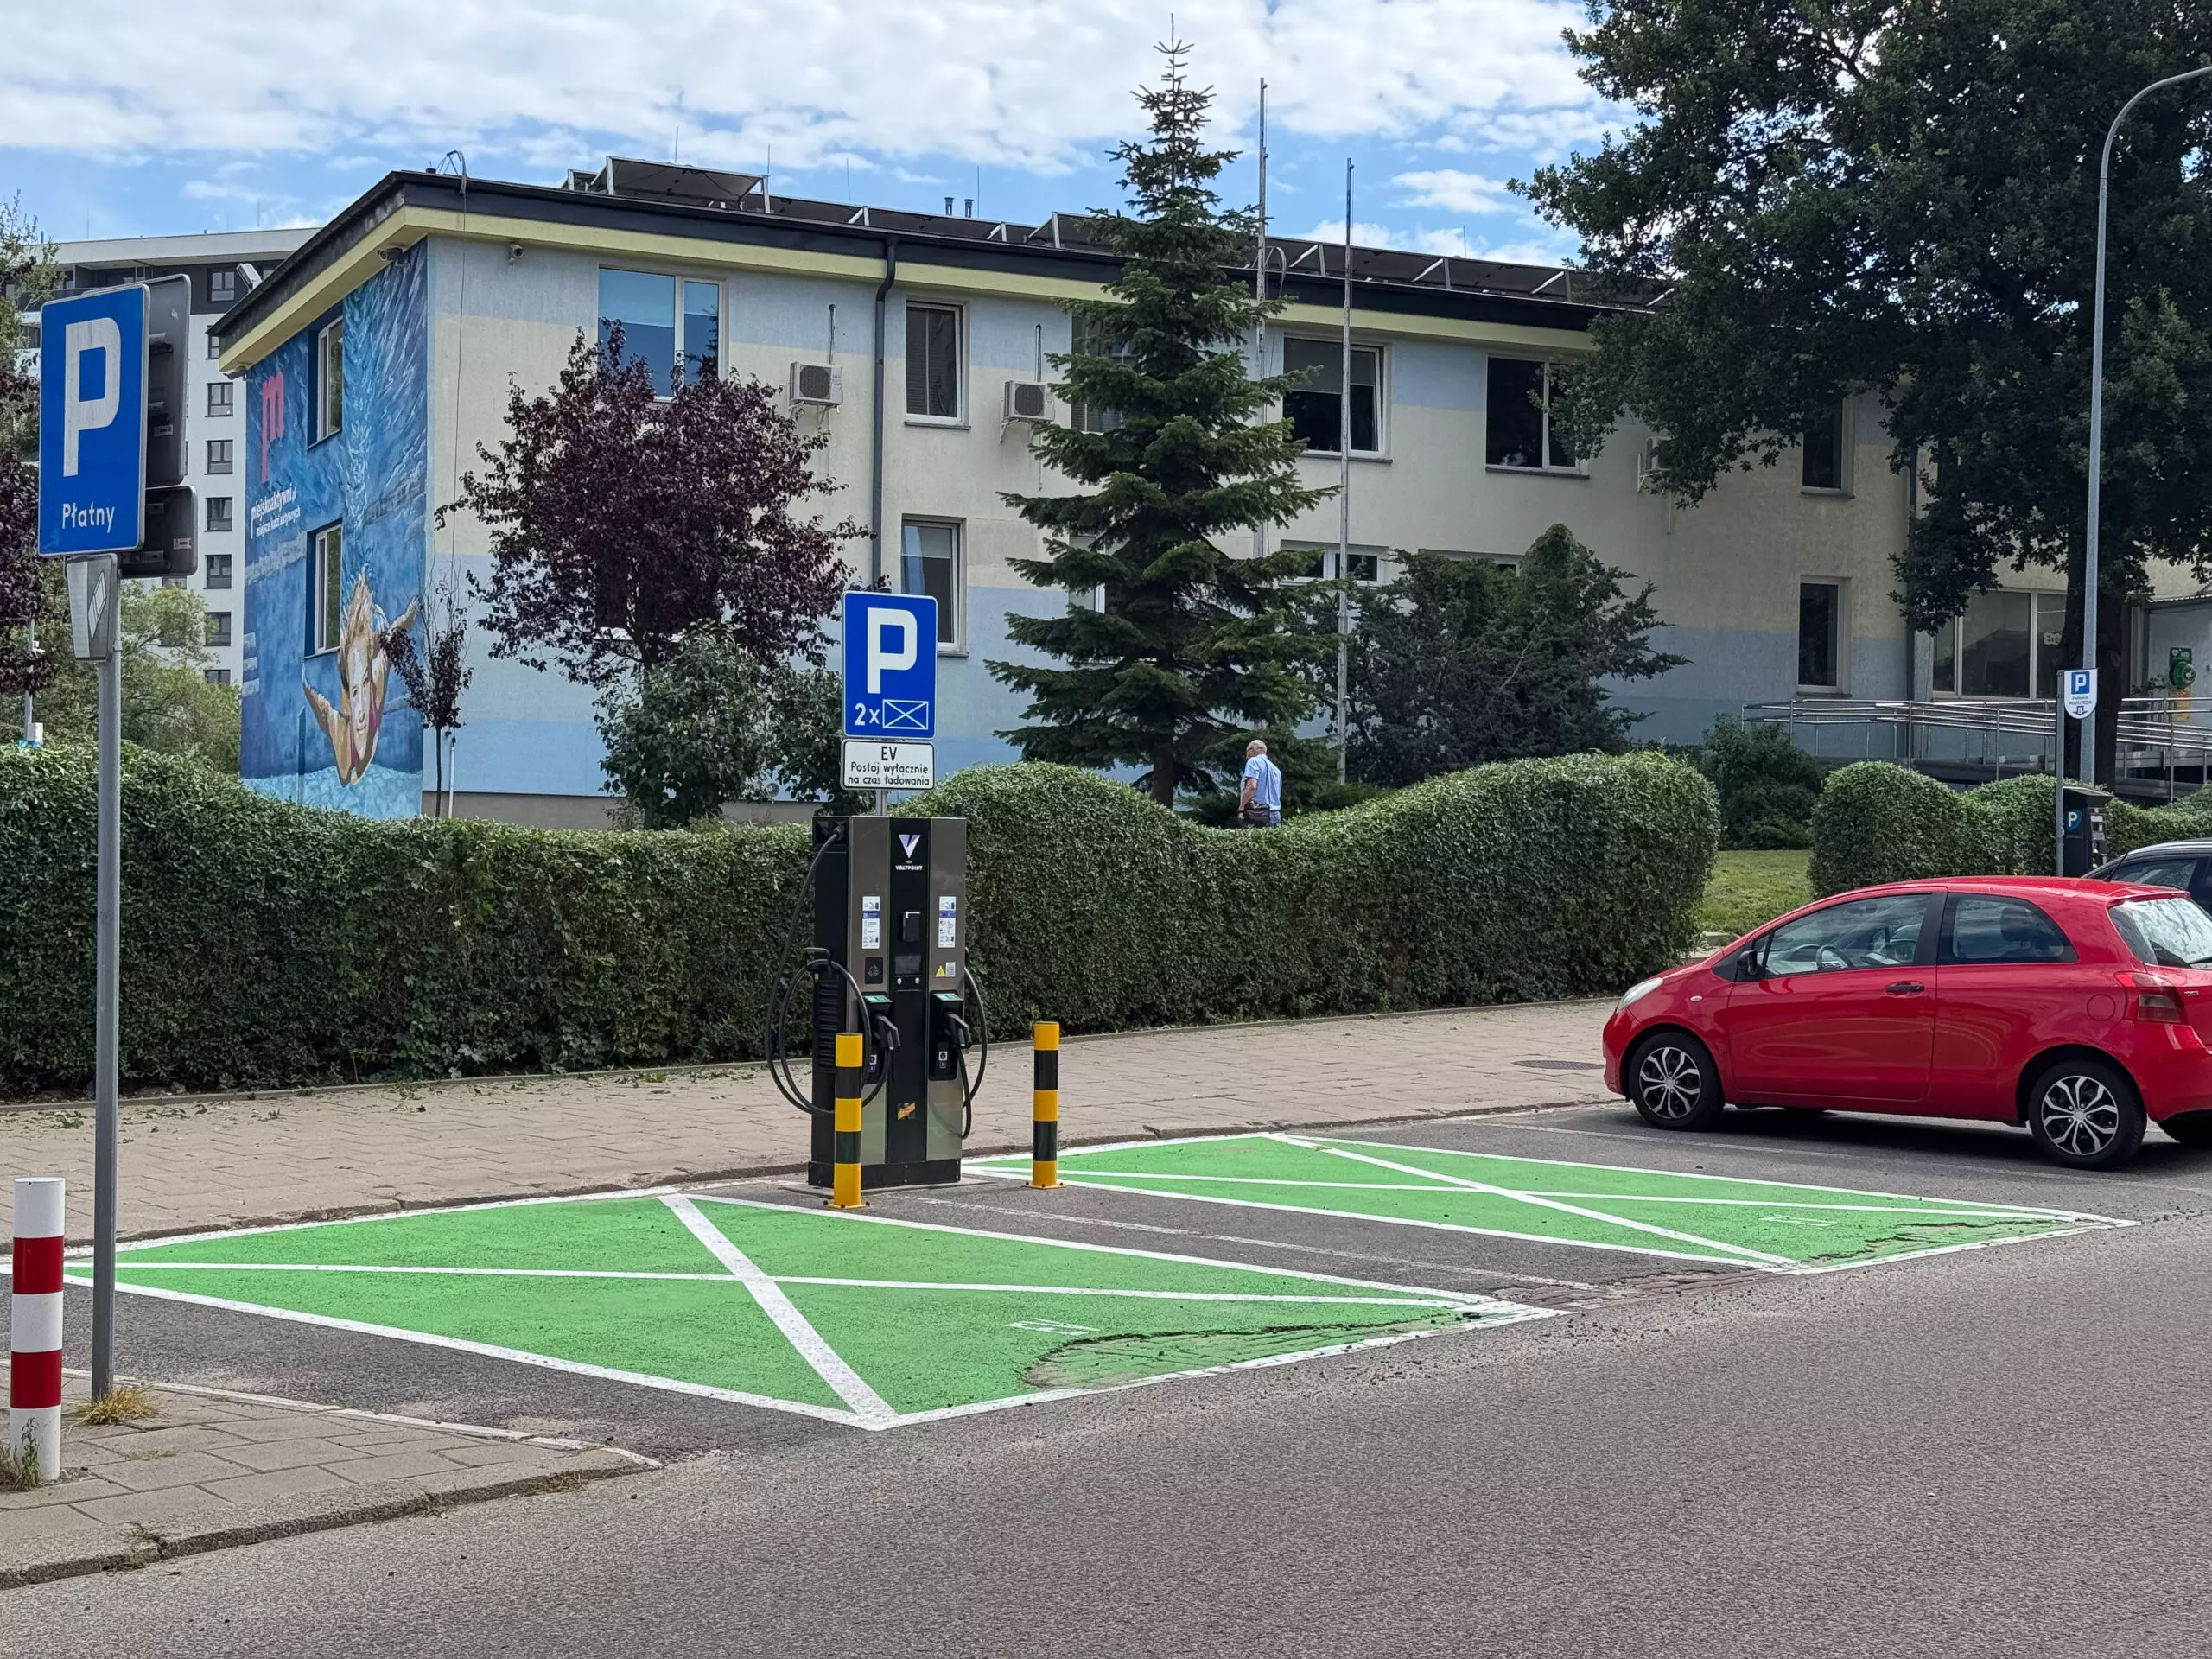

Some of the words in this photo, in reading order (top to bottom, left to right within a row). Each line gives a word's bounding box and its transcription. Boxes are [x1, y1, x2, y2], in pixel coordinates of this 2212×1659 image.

[63, 316, 122, 477] P
[62, 501, 115, 533] Płatny
[867, 607, 918, 694] P
[2075, 674, 2087, 692] P
[854, 703, 880, 726] 2x
[881, 746, 898, 761] EV
[850, 761, 880, 775] Postój
[883, 763, 929, 777] wyłącznie
[885, 774, 930, 785] ładowania
[2068, 811, 2078, 828] P
